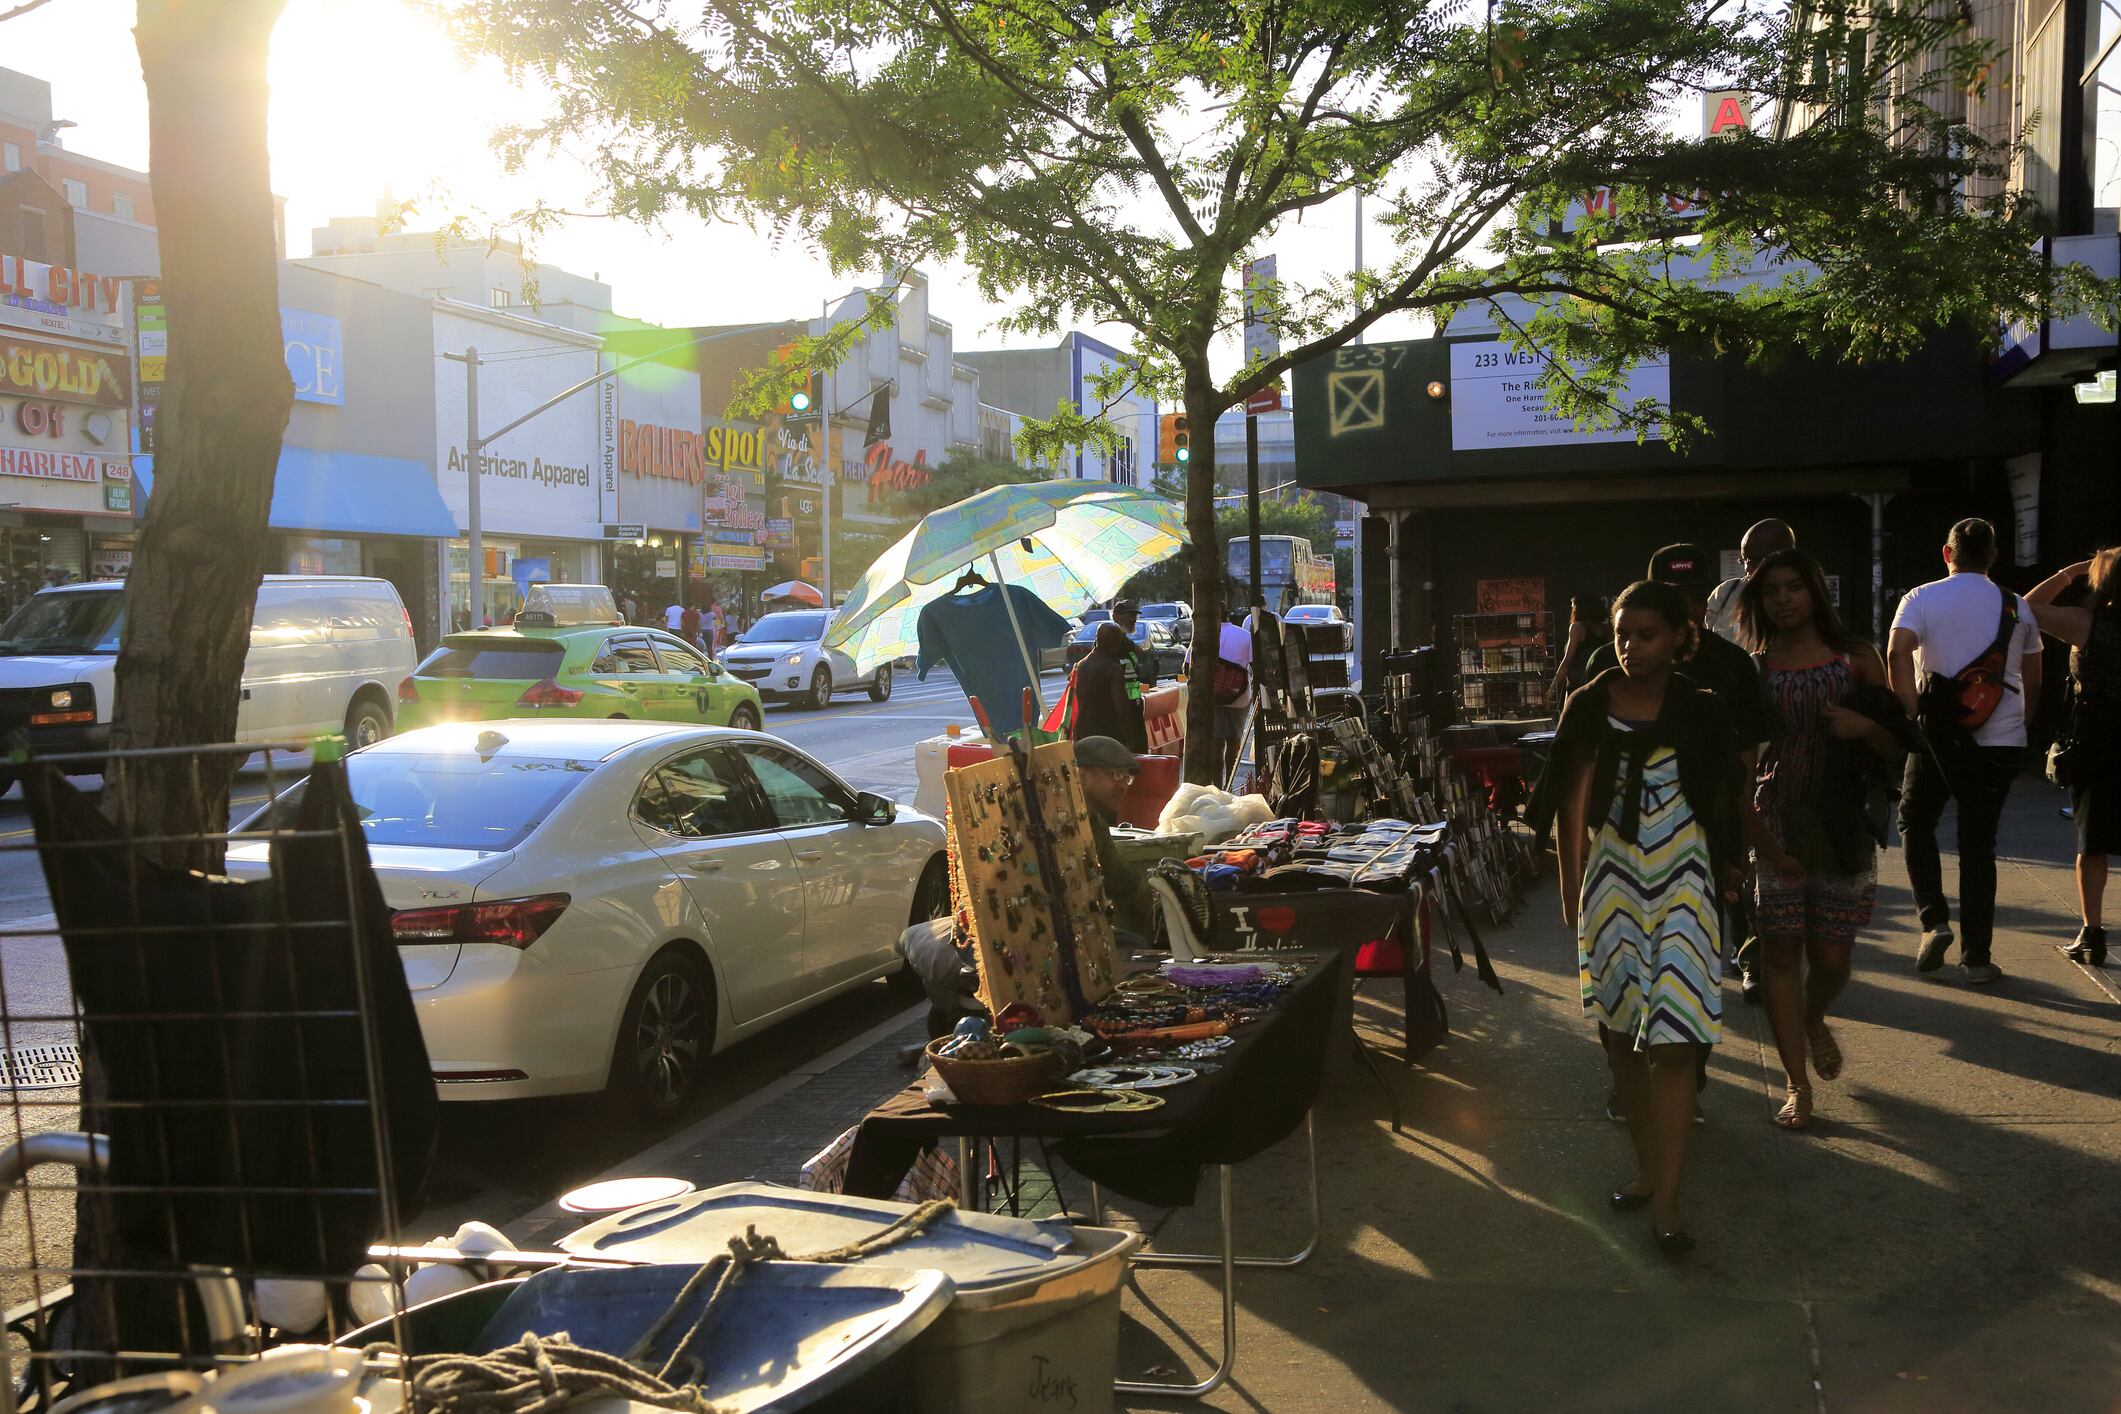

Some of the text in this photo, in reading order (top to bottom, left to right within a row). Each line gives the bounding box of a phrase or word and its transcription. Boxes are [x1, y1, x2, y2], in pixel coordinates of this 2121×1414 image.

[1711, 97, 1746, 134] A
[48, 265, 120, 314] CITY
[8, 347, 101, 396] GOLD
[1475, 353, 1498, 368] 233
[1502, 382, 1520, 391] The
[17, 401, 64, 438] Of
[1514, 429, 1548, 437] information,
[604, 382, 615, 493] American Apparel
[618, 418, 704, 487] BALLERS
[708, 426, 766, 472] spot
[0, 448, 97, 482] HARLEM
[110, 465, 129, 477] 248
[532, 457, 590, 488] Apparel
[723, 476, 744, 508] igh
[1229, 906, 1254, 932] I
